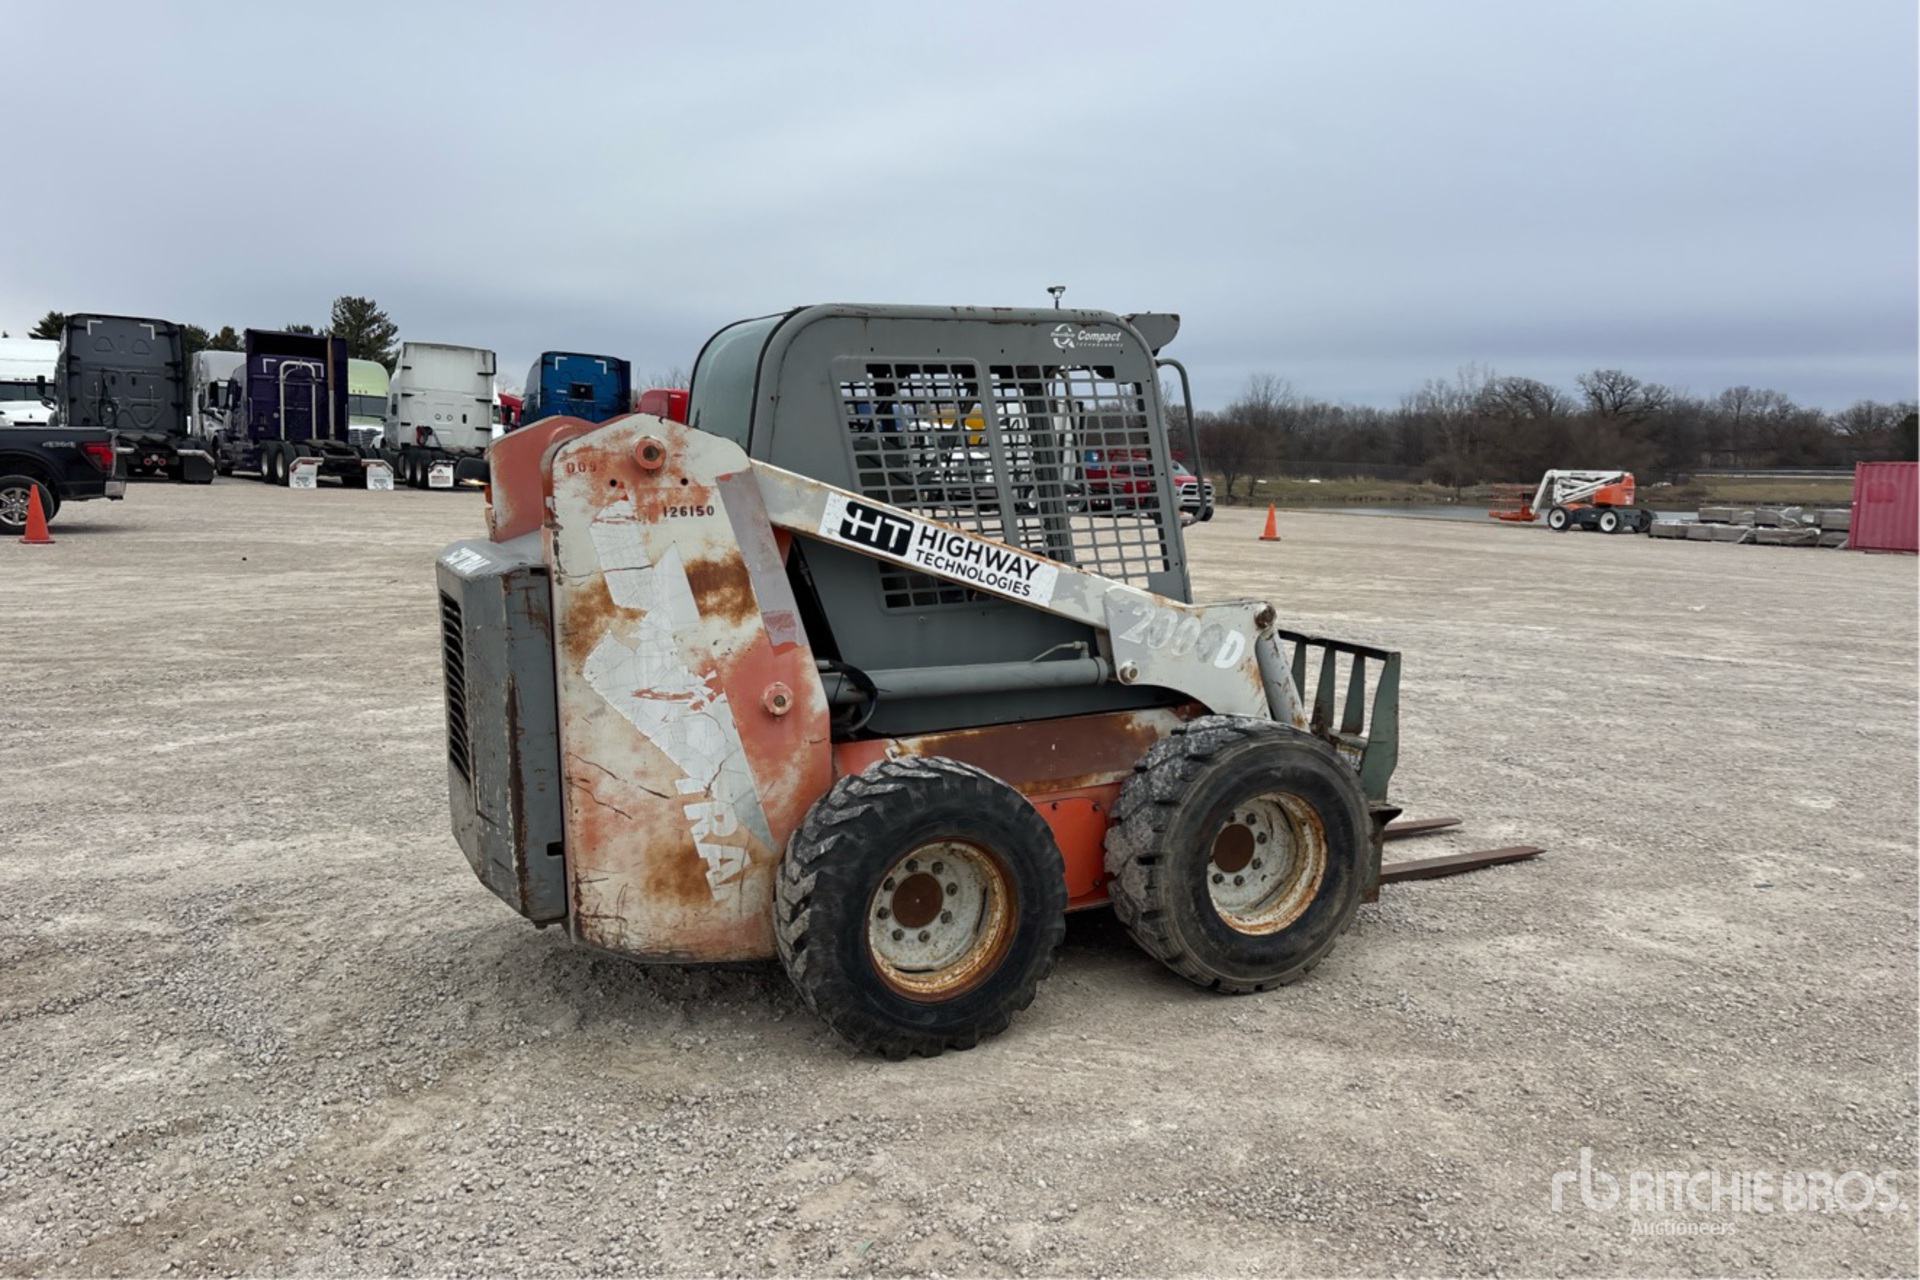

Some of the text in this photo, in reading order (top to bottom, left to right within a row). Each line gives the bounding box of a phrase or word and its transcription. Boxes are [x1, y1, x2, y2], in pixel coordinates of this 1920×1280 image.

[1078, 329, 1121, 344] Compact
[663, 504, 715, 518] 126150
[843, 505, 912, 551] HT
[915, 549, 1032, 597] TECHNOLOGIES
[918, 525, 1041, 582] HIGHWAY
[1119, 602, 1247, 669] 2000D
